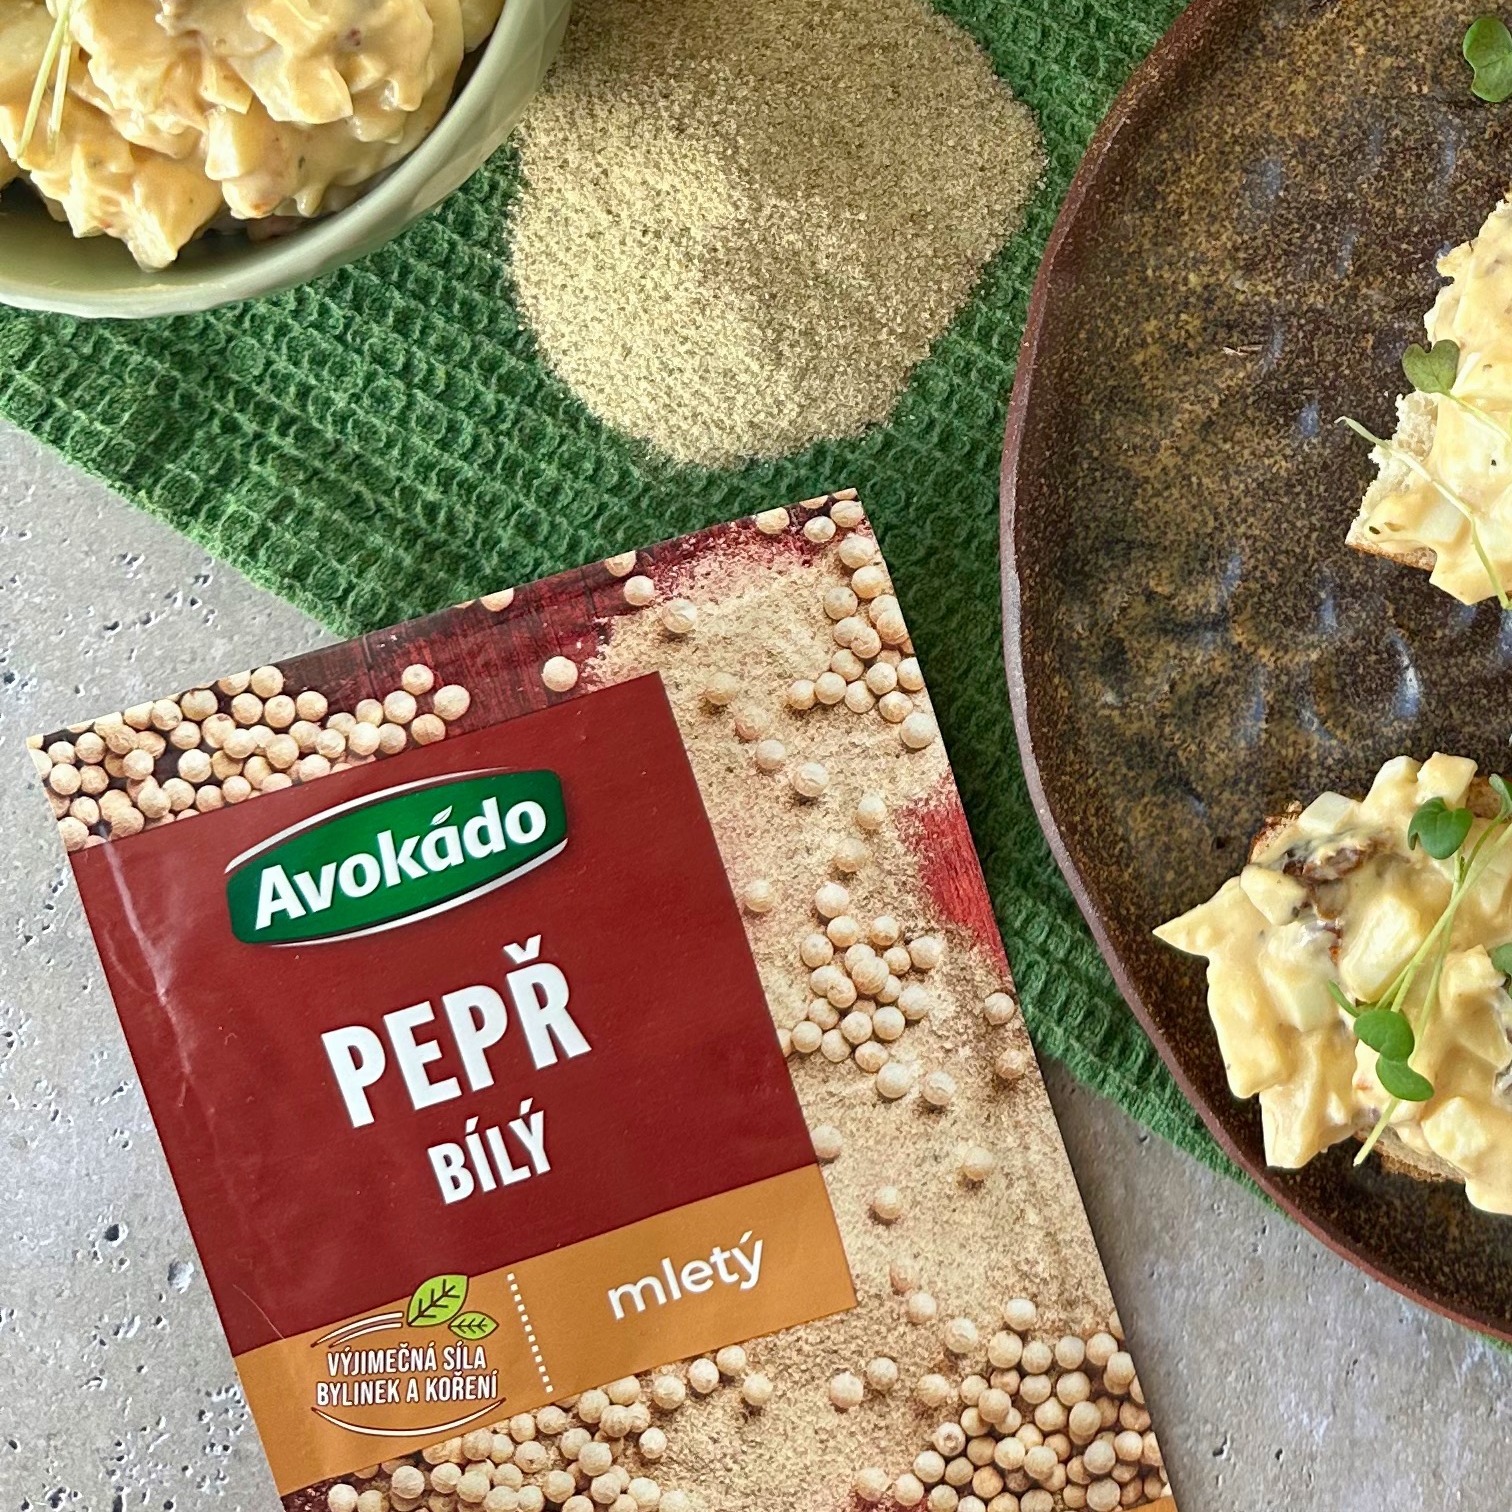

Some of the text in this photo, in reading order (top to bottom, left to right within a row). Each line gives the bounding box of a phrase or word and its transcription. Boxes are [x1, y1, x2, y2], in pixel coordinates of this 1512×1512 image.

[254, 794, 548, 930] Avokádo
[321, 934, 592, 1128] PEPŘ
[427, 1098, 552, 1205] BÍLÝ
[607, 1230, 764, 1320] mletý
[316, 1368, 499, 1406] BYLINEK A KOŘENÍ
[326, 1340, 487, 1377] VÝJIMEČNÁ SÍLA
